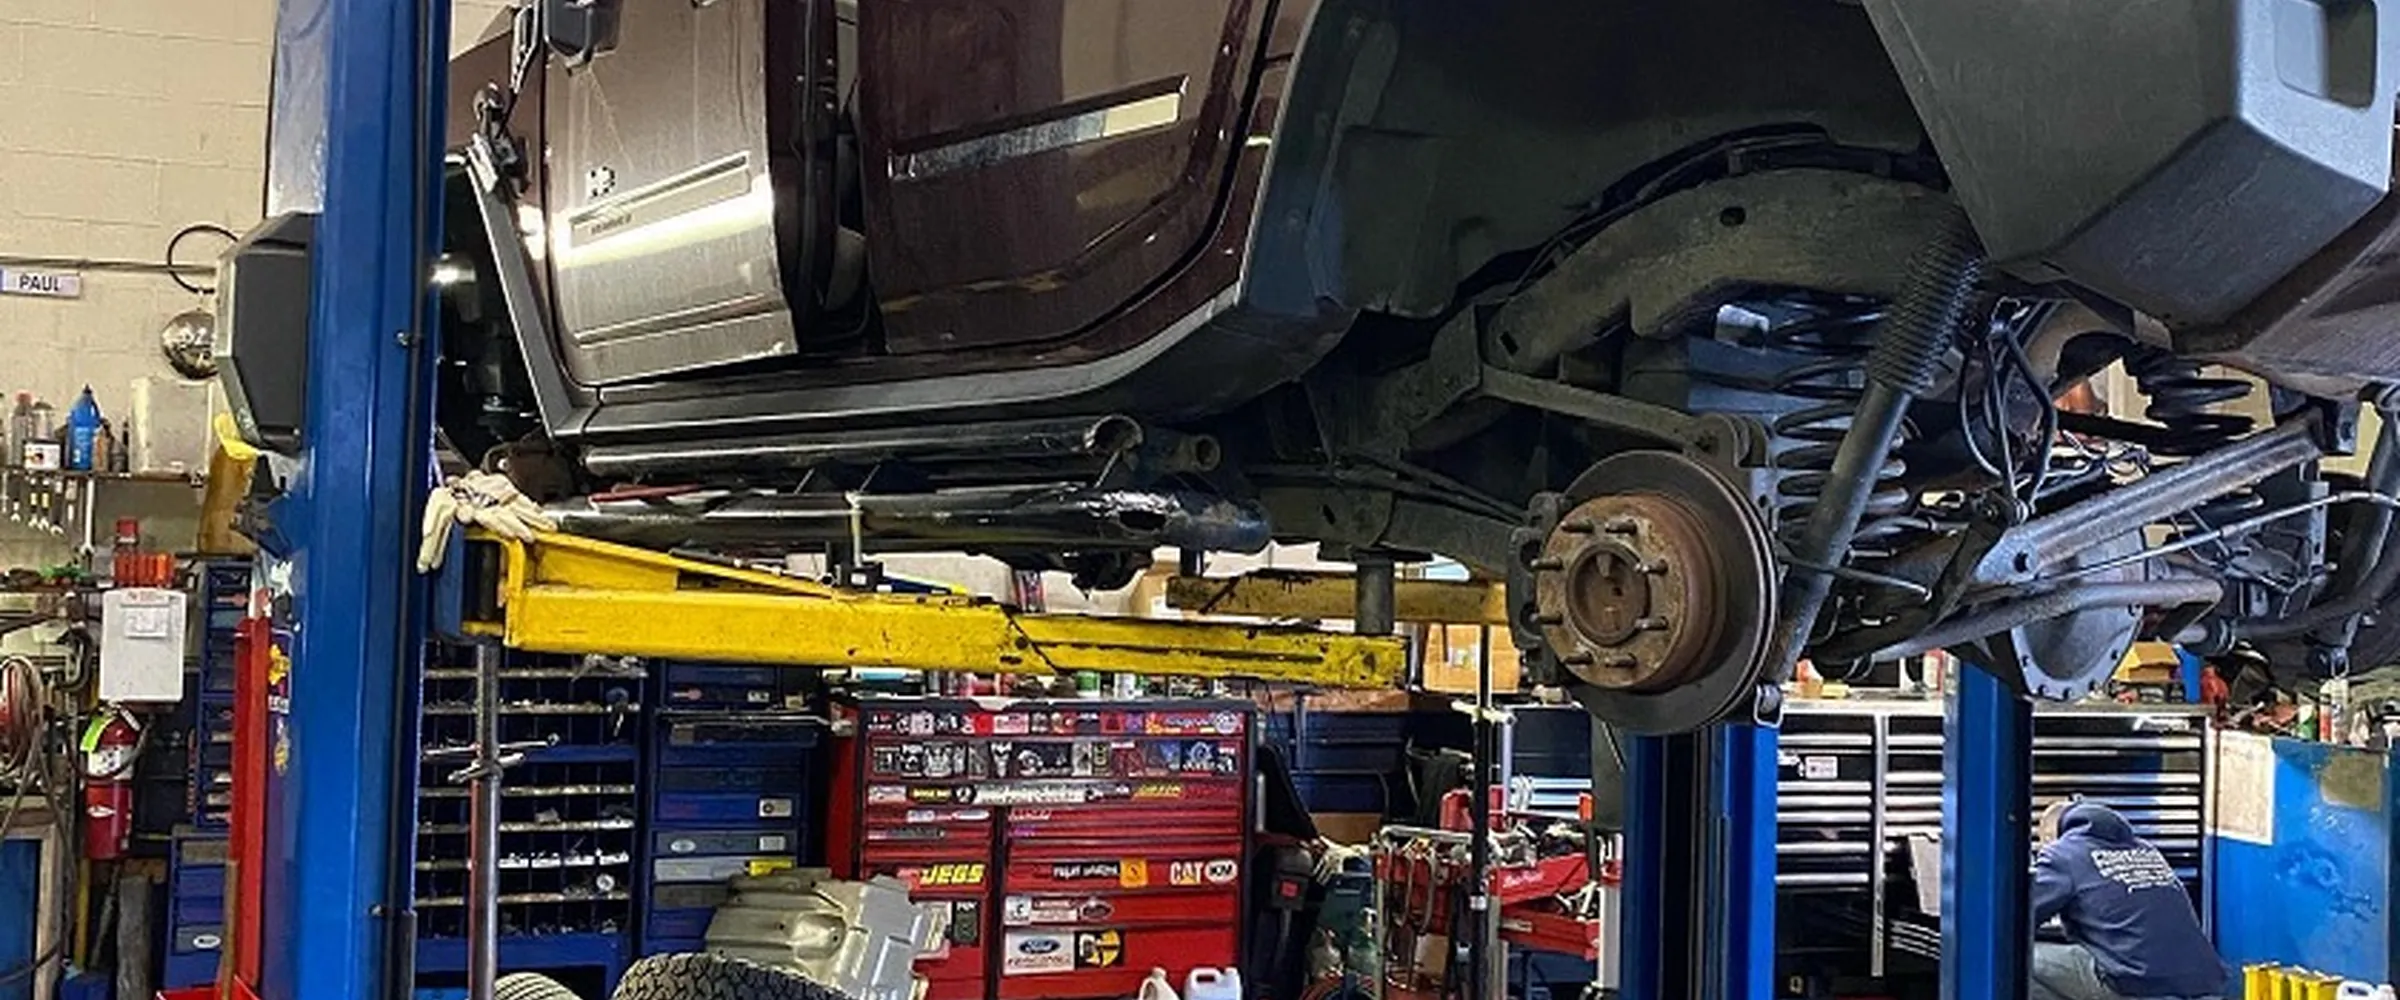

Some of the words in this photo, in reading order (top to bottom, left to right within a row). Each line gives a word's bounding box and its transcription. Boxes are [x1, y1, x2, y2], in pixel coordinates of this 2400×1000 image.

[19, 274, 60, 292] PAUL
[919, 864, 986, 885] JEGS
[1170, 862, 1205, 885] CAT
